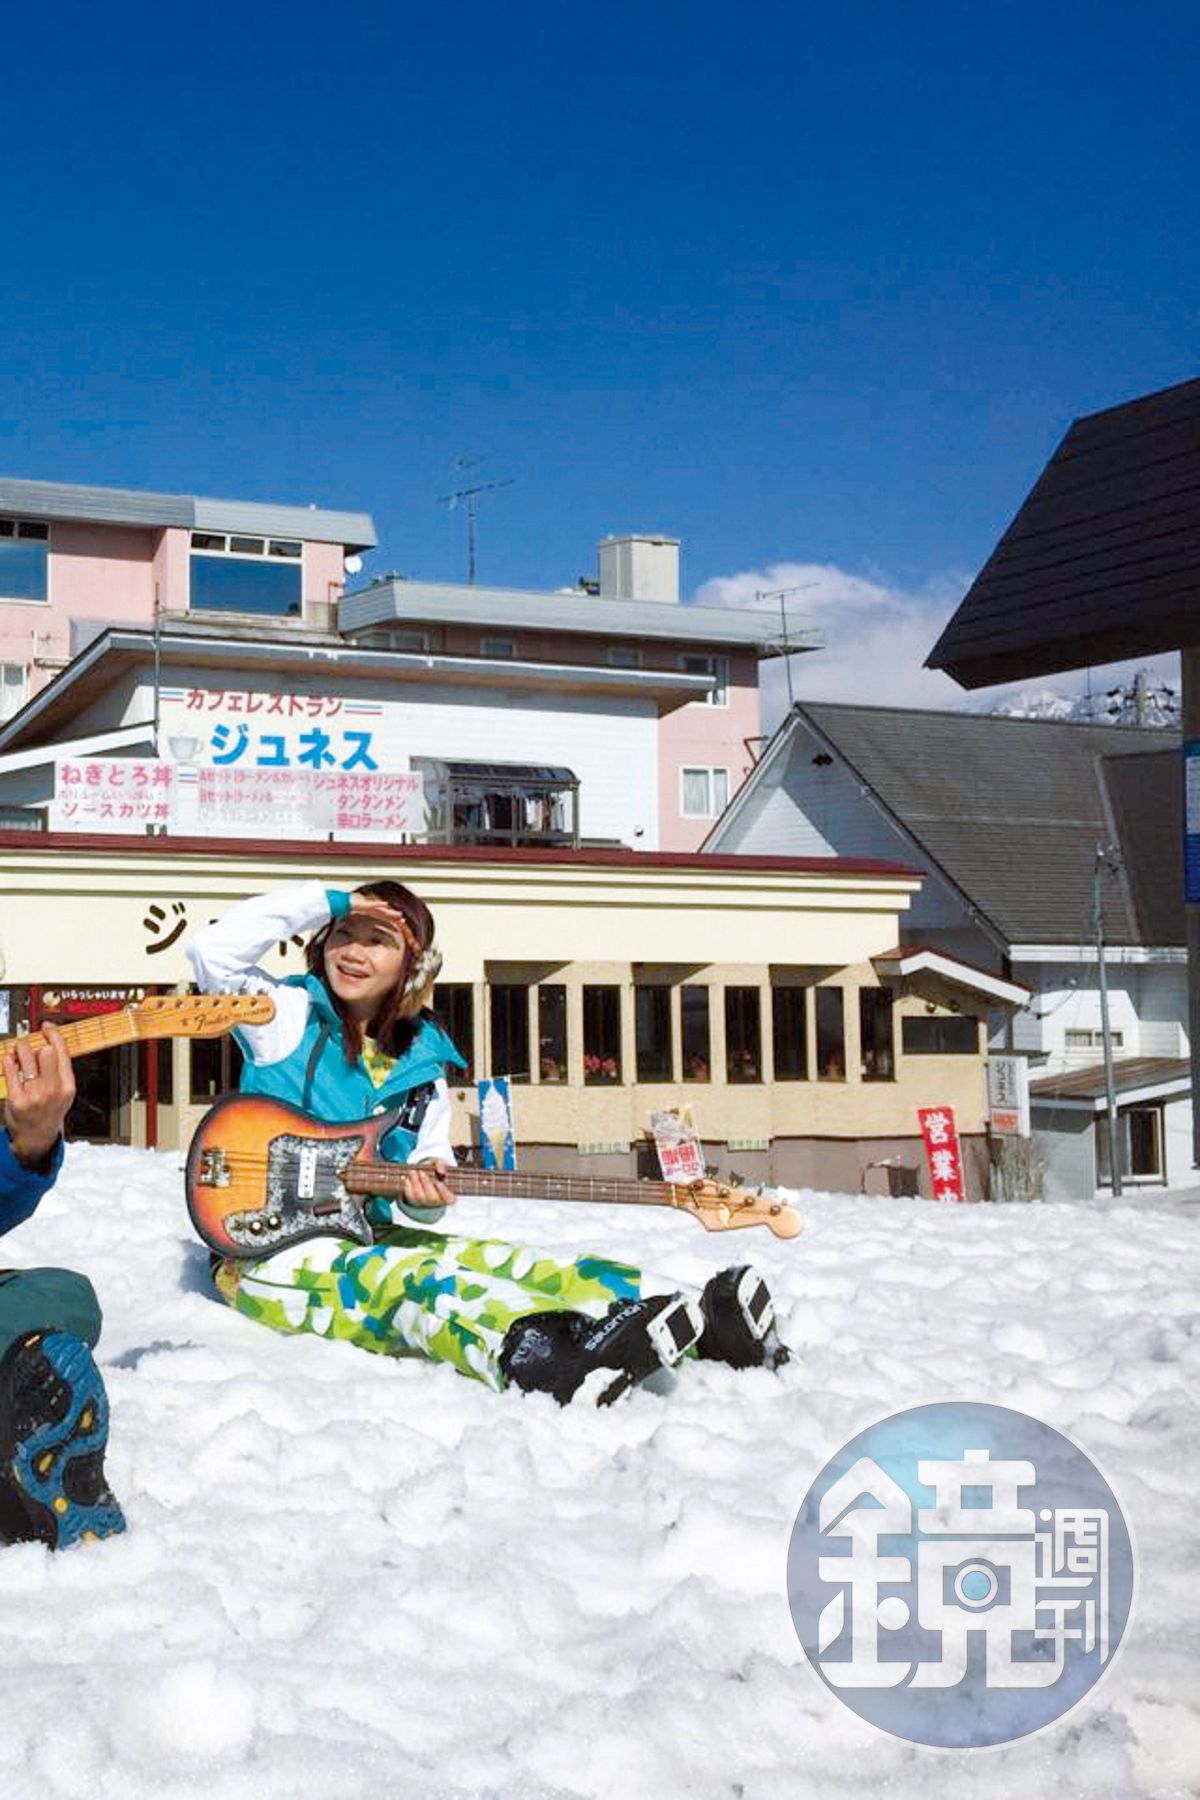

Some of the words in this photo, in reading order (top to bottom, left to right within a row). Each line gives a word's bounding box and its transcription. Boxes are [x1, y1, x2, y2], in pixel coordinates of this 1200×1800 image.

[187, 688, 343, 717] カフェレストラン
[209, 722, 379, 771] ジュネス
